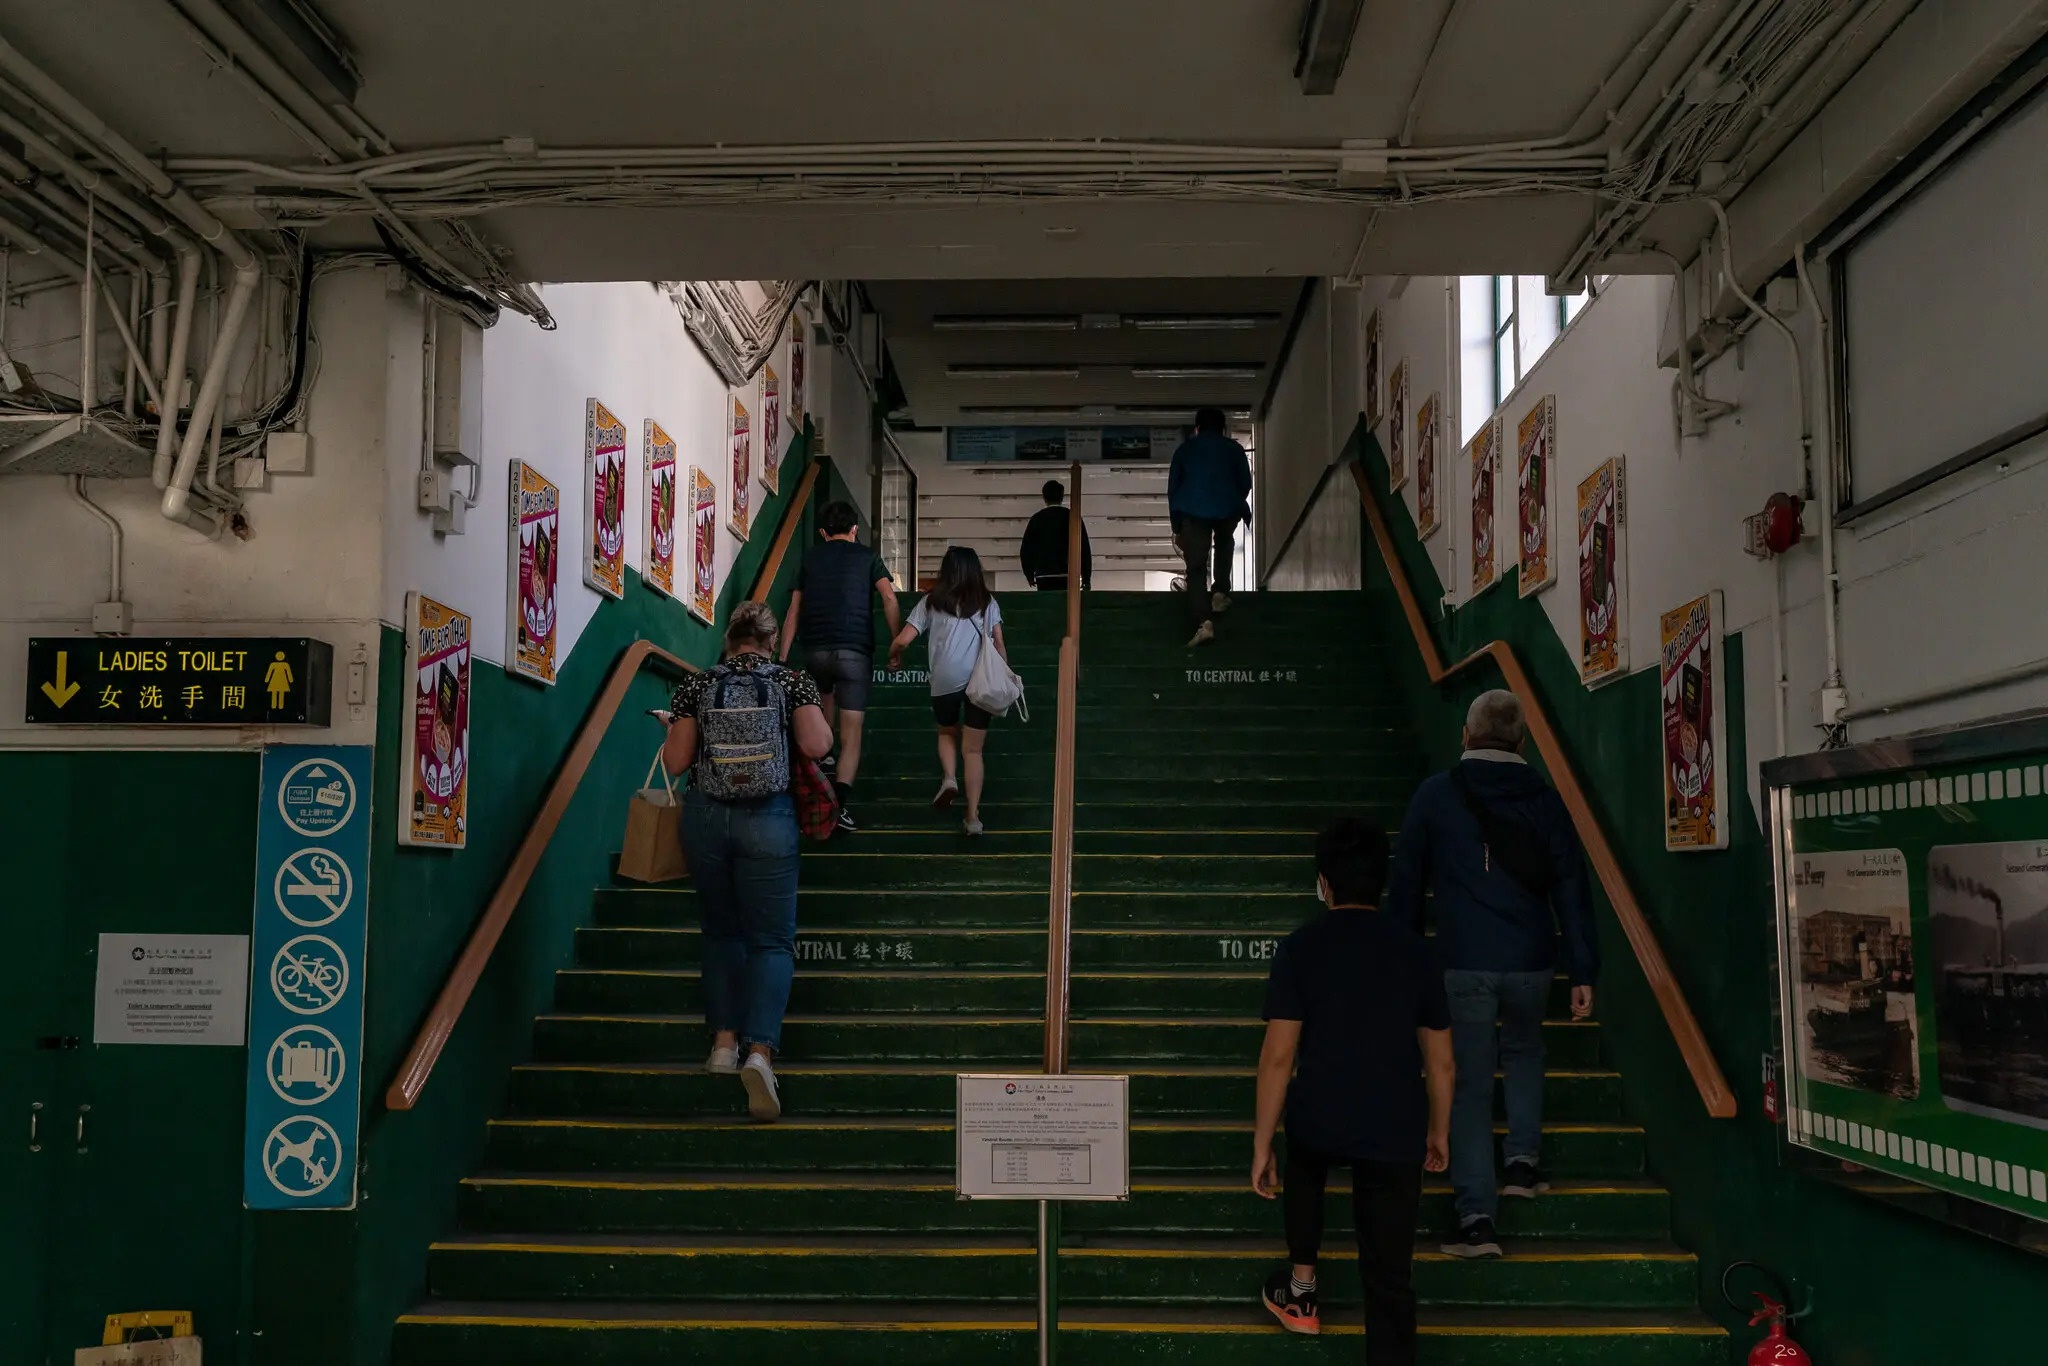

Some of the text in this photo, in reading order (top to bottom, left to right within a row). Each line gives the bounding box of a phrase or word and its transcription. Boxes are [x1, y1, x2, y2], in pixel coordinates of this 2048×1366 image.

[586, 410, 594, 459] 206L3
[419, 616, 467, 656] TIME FOR THAI
[1663, 599, 1707, 671] TIME FOR THAI
[99, 651, 248, 671] LADIES TOILET
[888, 670, 930, 683] CENTRA
[1185, 670, 1201, 682] TO
[1203, 670, 1256, 682] CENTRAL
[98, 684, 246, 710] 女洗手間
[296, 817, 337, 826] Pay Upstairs
[853, 941, 914, 961] 往中環
[1219, 939, 1243, 960] TO
[1774, 1344, 1797, 1359] 20
